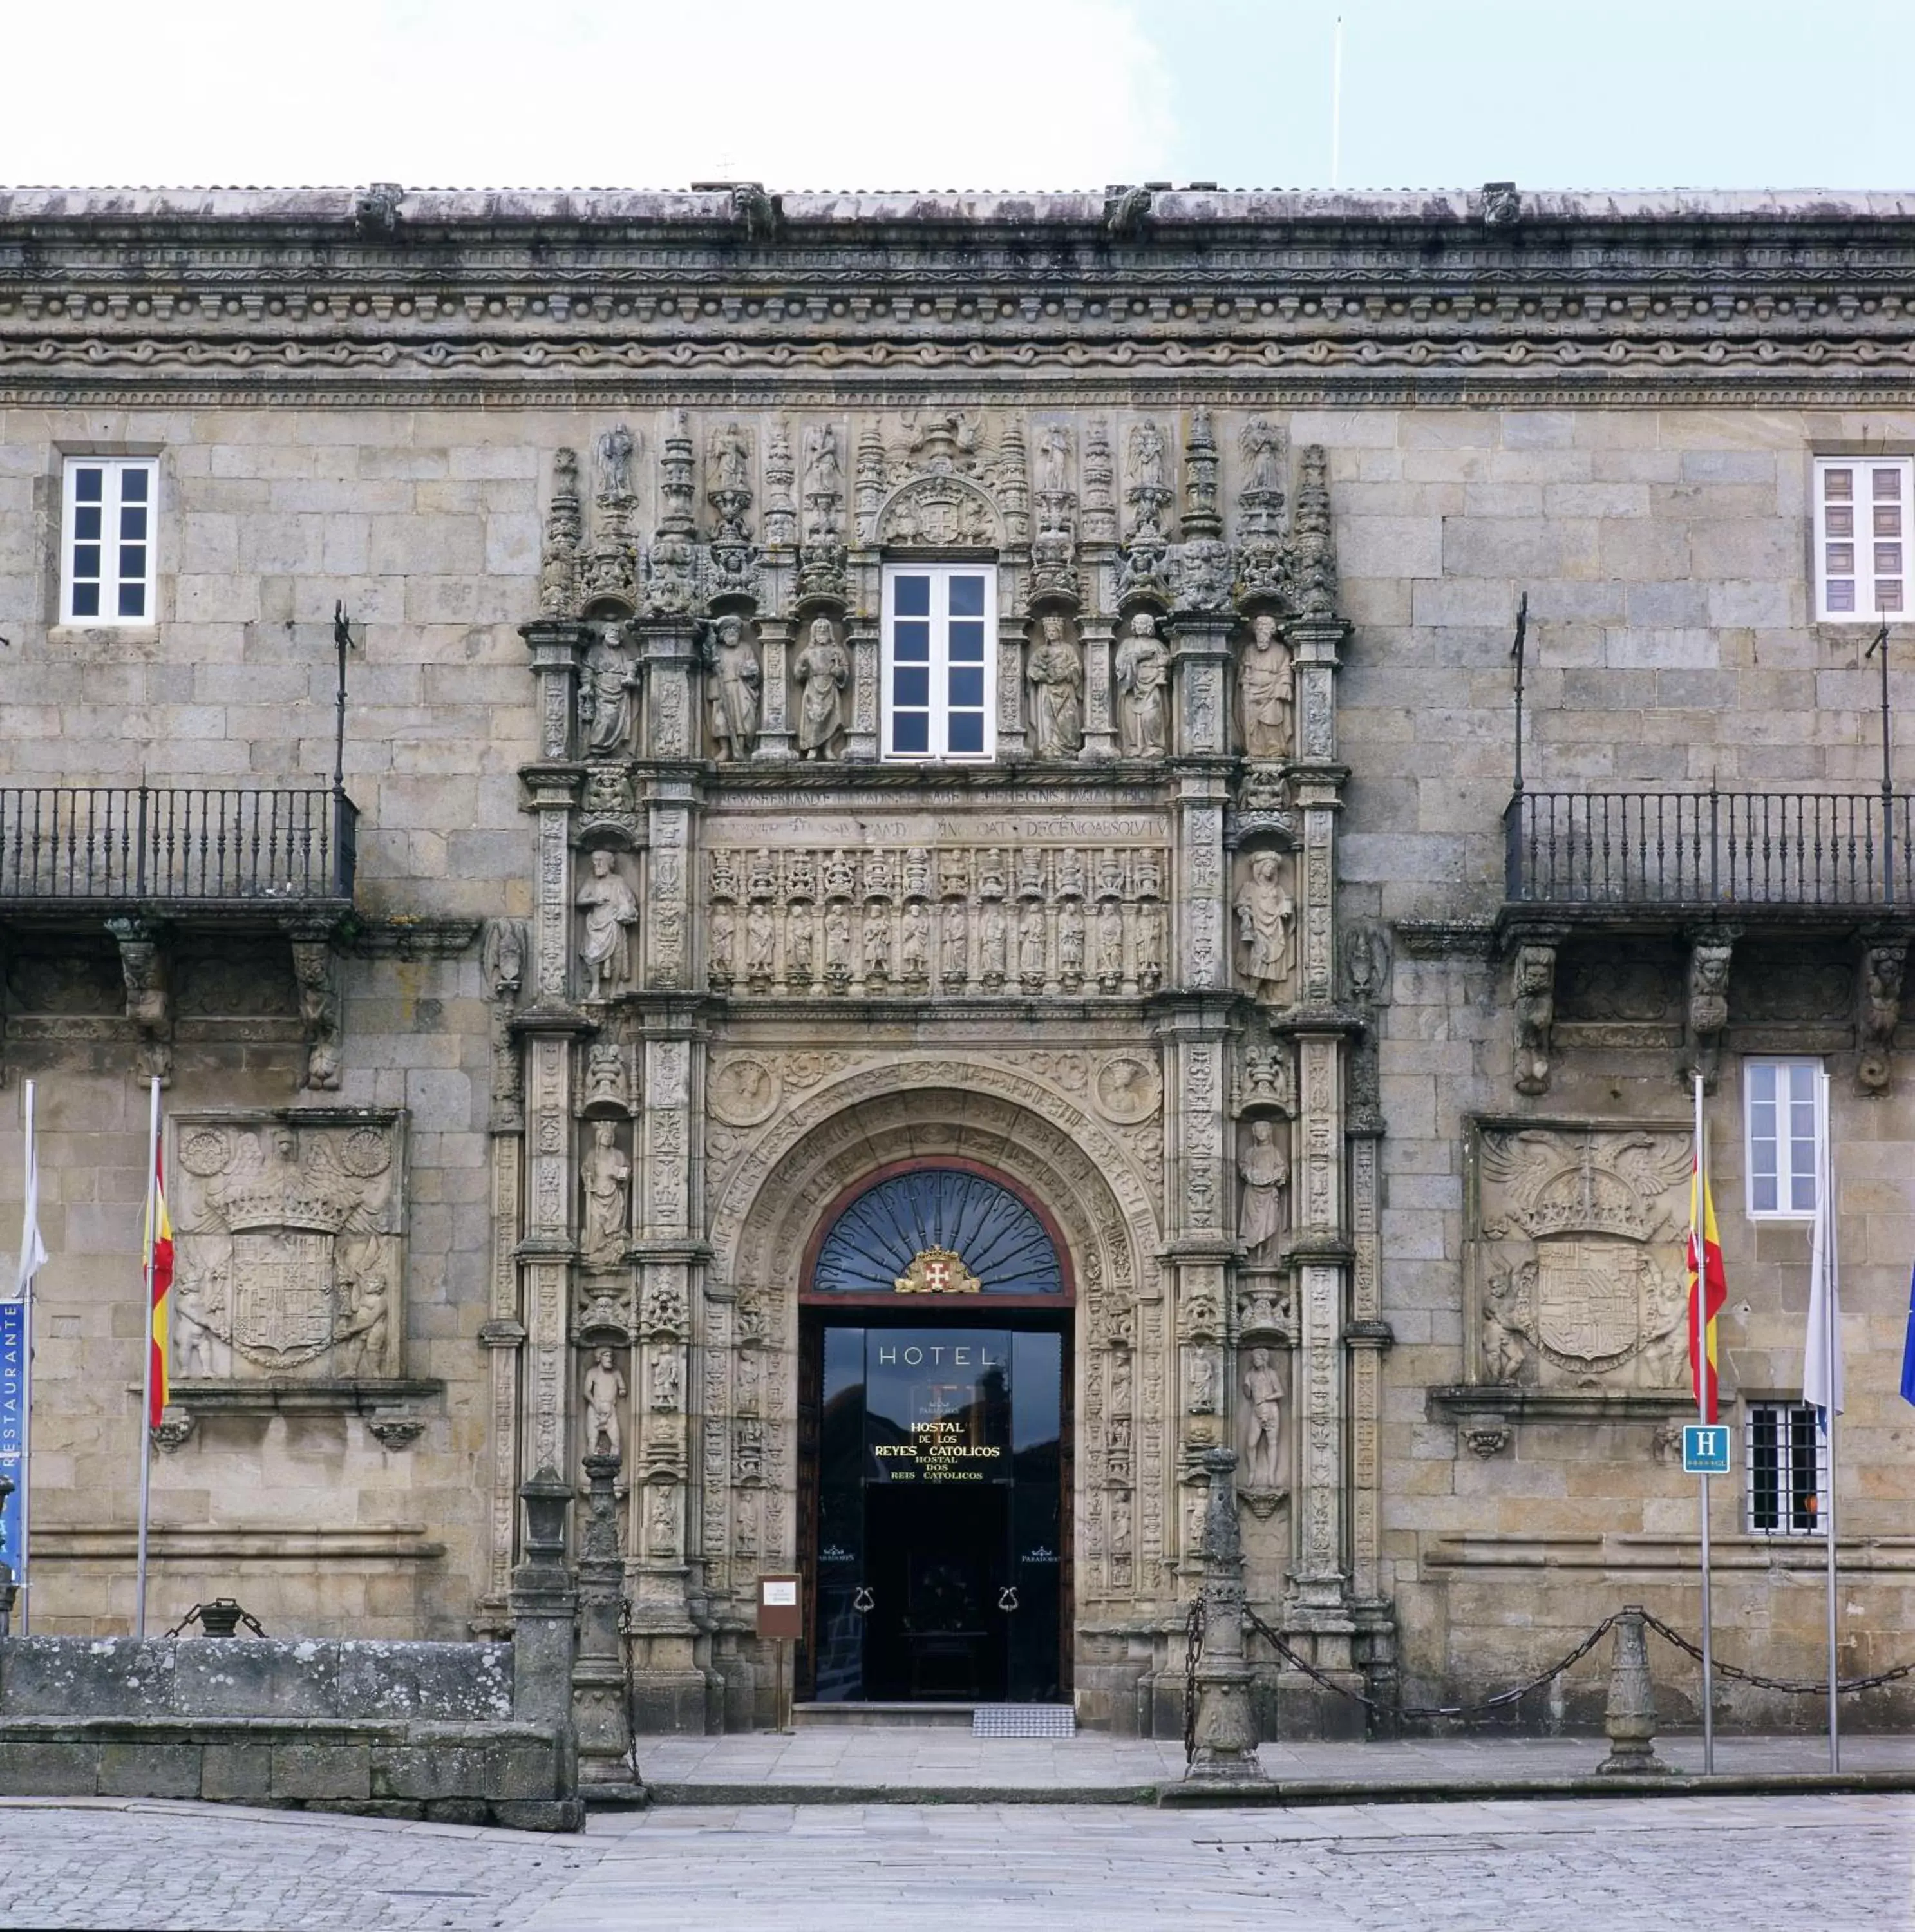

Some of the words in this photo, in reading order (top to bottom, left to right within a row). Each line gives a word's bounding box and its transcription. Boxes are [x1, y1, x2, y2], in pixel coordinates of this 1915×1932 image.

[880, 1346, 997, 1365] HOTEL
[4, 1307, 17, 1467] RESTAURANTE
[911, 1422, 965, 1433] HOSTAL
[919, 1435, 930, 1443] DE
[938, 1435, 958, 1443] LOS
[1696, 1431, 1716, 1456] H
[874, 1446, 918, 1457] REYES
[929, 1446, 1001, 1457] CATOLICOS
[923, 1472, 983, 1480] CATOLICOS
